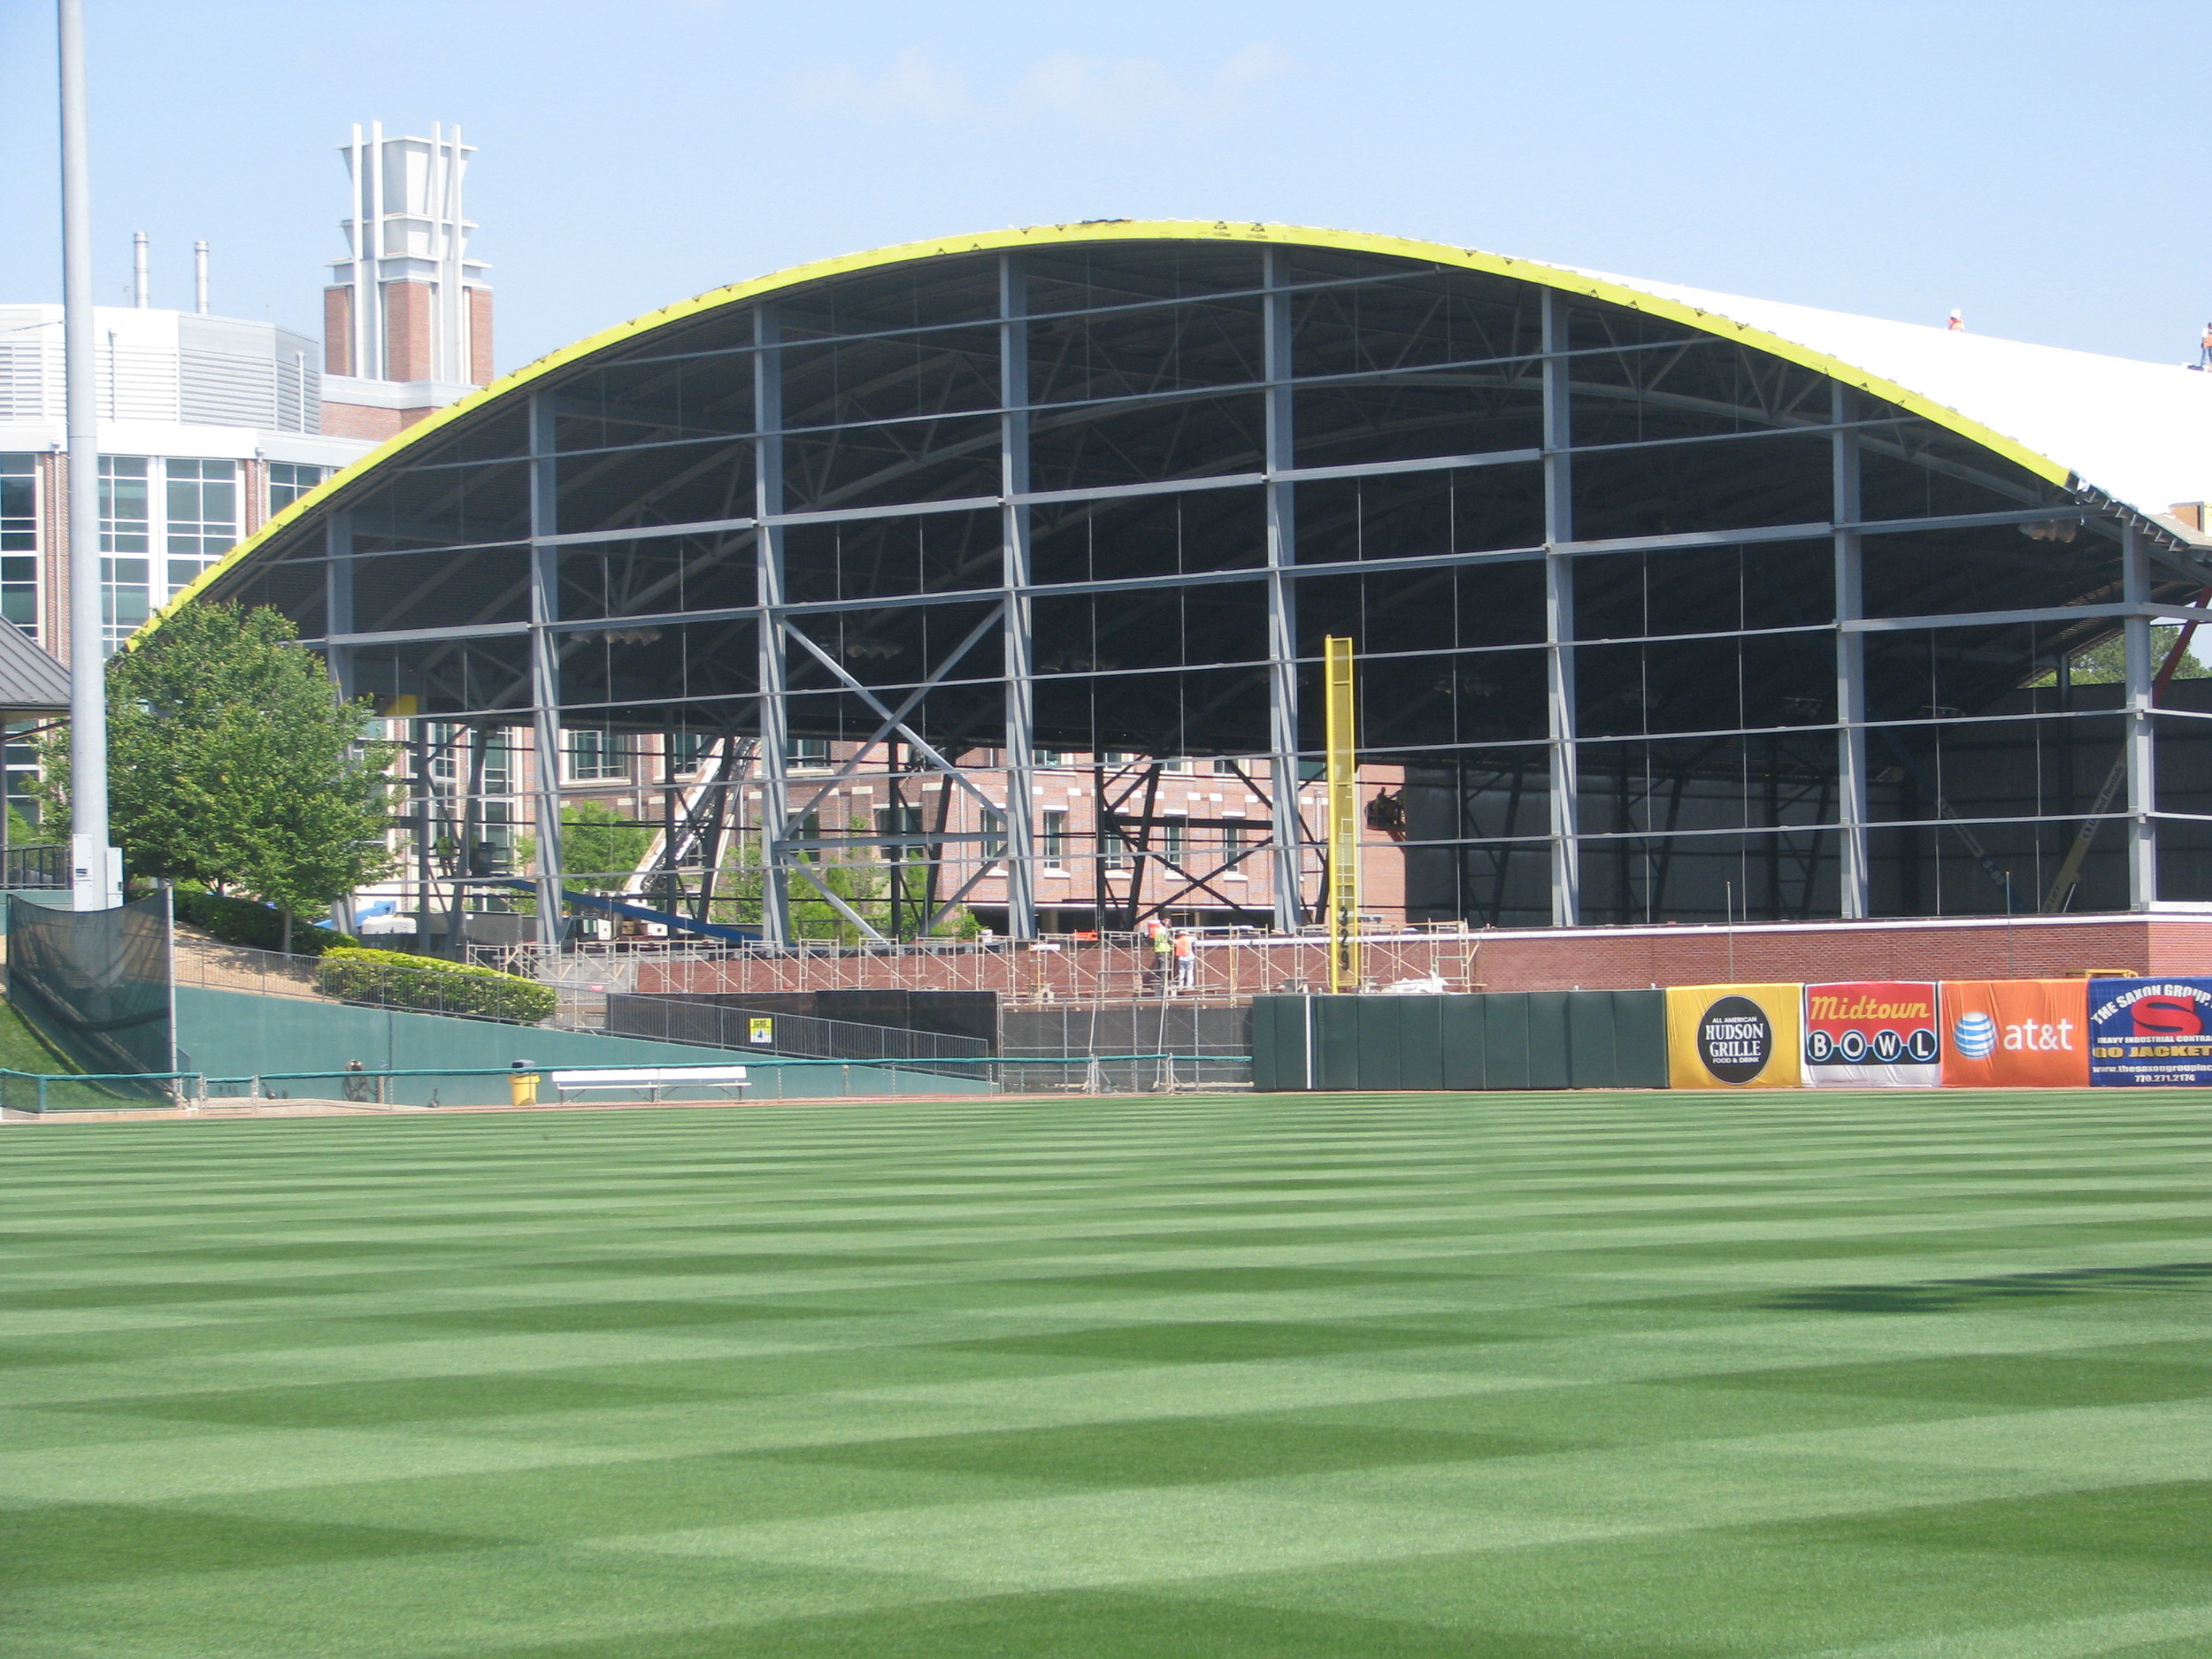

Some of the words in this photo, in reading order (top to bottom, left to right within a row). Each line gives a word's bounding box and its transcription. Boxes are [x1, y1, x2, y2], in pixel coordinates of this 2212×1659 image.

[1340, 906, 1349, 971] 329
[1810, 995, 1931, 1019] Midtown
[2090, 1002, 2119, 1025] THE
[2116, 985, 2161, 1008] SAXON
[1705, 1024, 1763, 1041] HUDSON
[2003, 1018, 2074, 1050] at&t
[1709, 1041, 1762, 1057] GRILLE
[2092, 1047, 2124, 1057] GO
